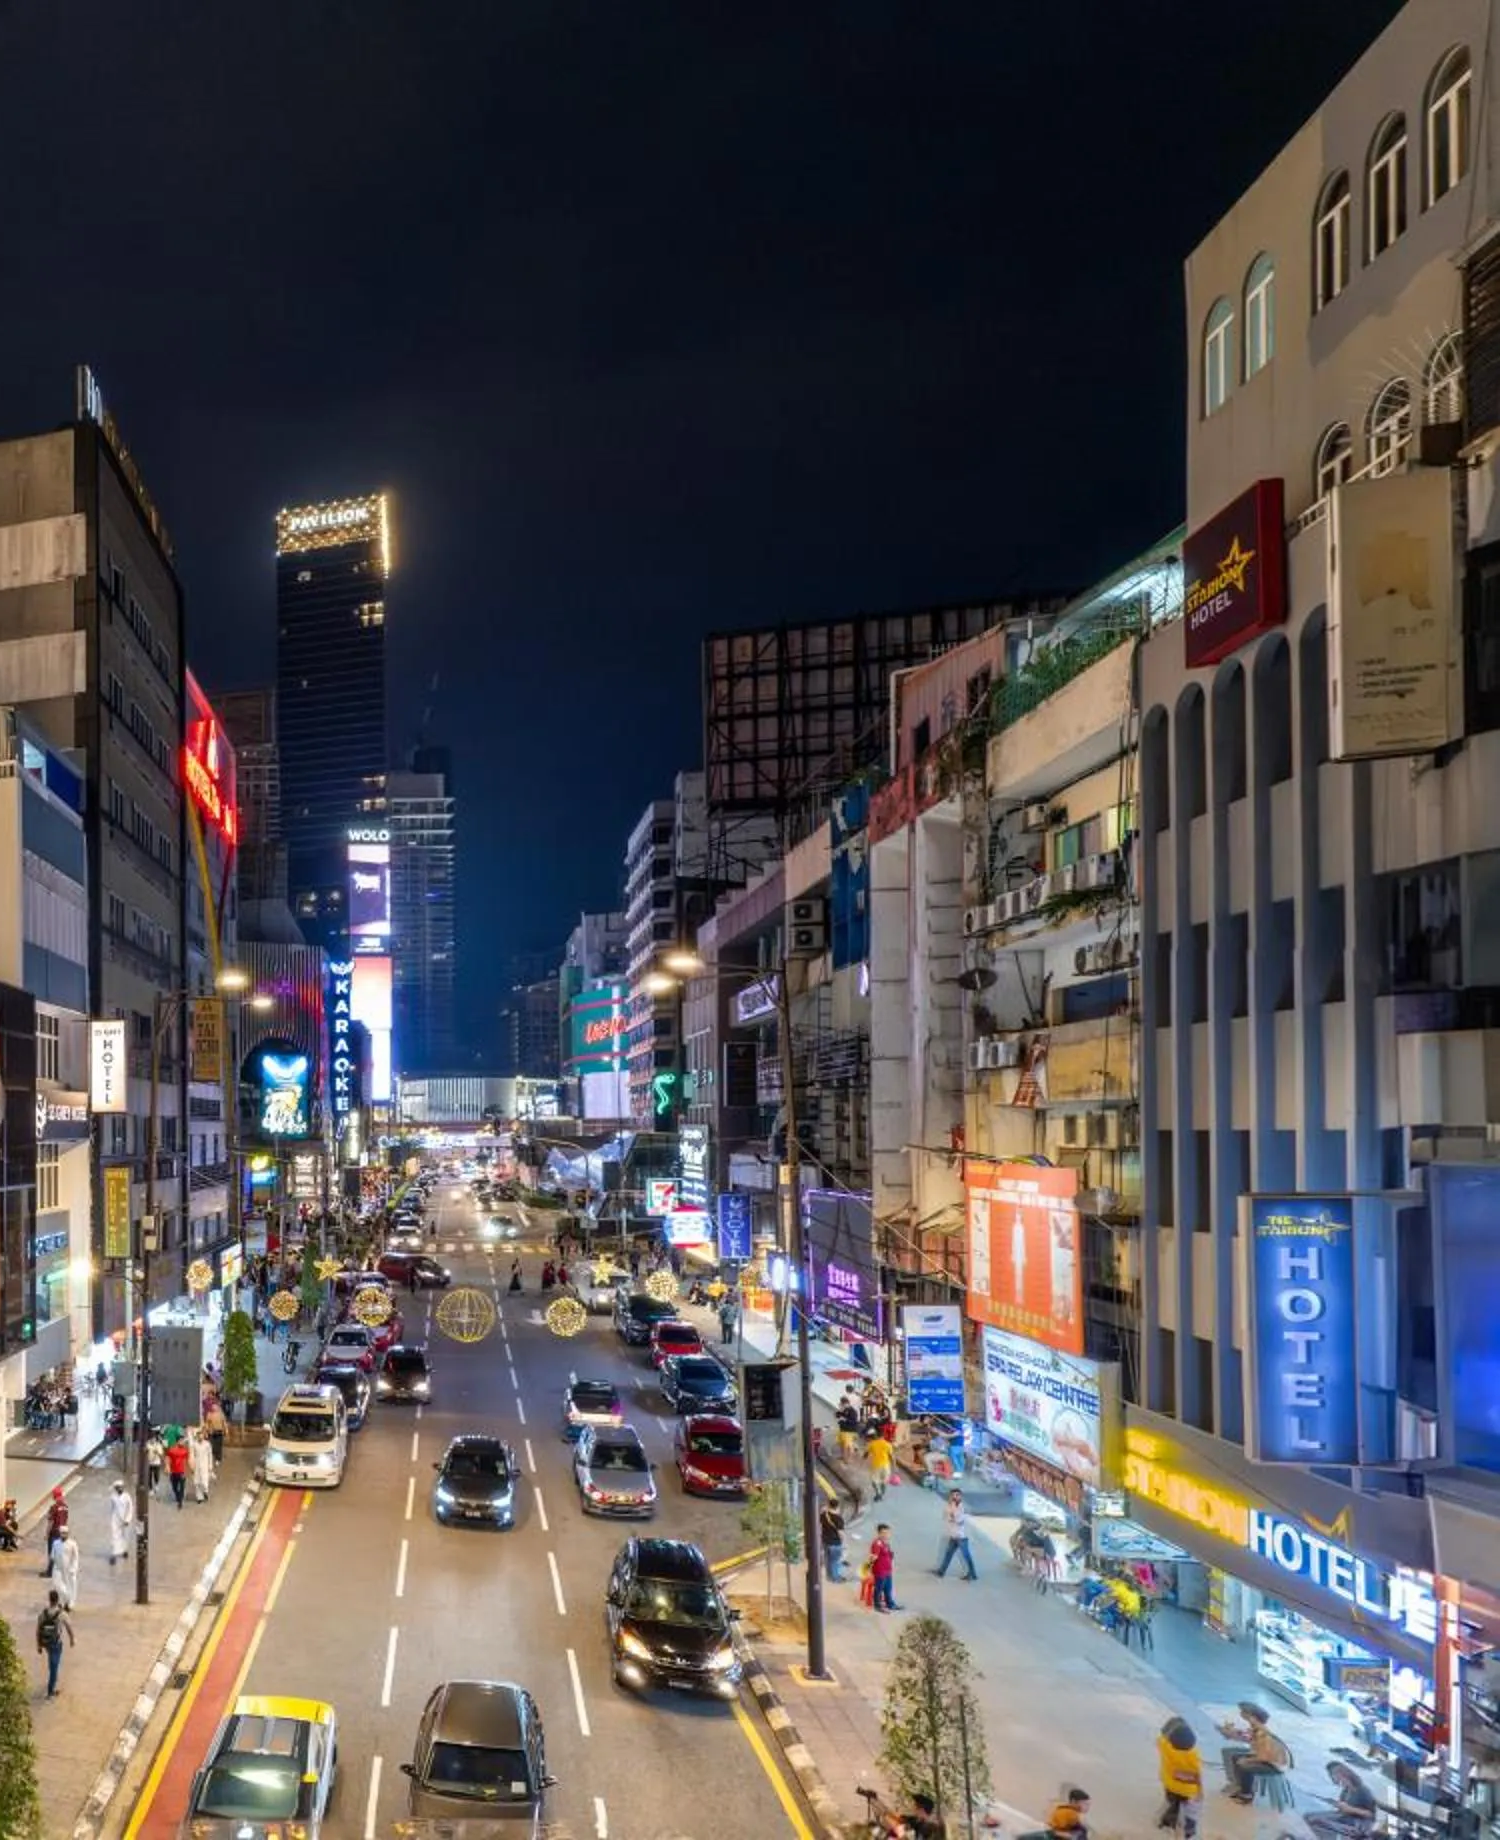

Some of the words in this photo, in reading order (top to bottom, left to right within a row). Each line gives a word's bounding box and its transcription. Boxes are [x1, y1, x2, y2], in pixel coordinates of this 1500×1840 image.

[291, 507, 369, 531] PAVILION
[1191, 590, 1232, 631] HOTEL
[348, 829, 390, 841] WOLO
[102, 1039, 113, 1105] HOTEL
[335, 980, 349, 1111] KARAOKE
[1278, 1247, 1323, 1451] HOTEL
[1043, 1376, 1101, 1417] CENTRE
[1250, 1508, 1384, 1616] HOTEL
